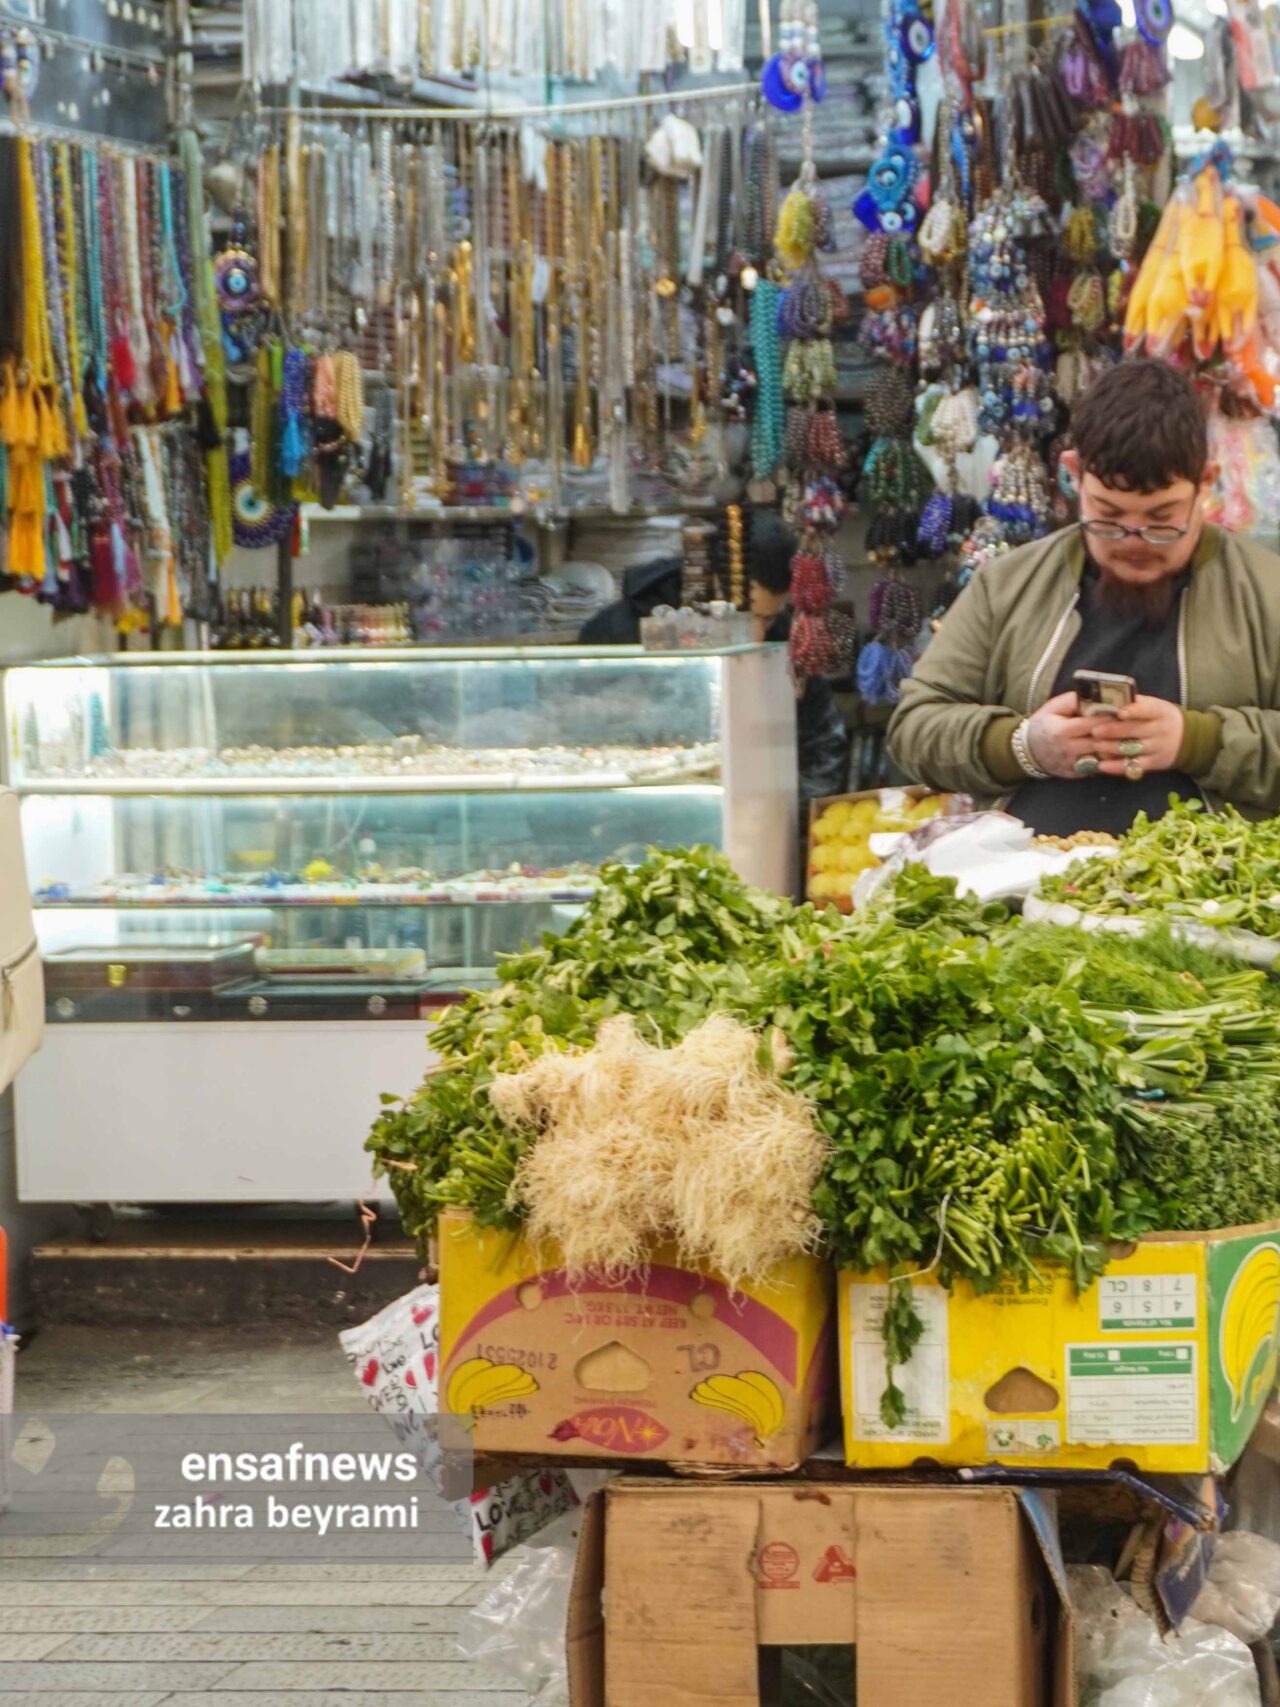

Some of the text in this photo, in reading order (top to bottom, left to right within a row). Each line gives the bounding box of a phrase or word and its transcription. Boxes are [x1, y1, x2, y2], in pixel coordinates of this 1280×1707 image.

[1107, 1278, 1183, 1293] 7 8 CL
[1113, 1300, 1183, 1313] 4 5 6
[676, 1343, 722, 1373] CL
